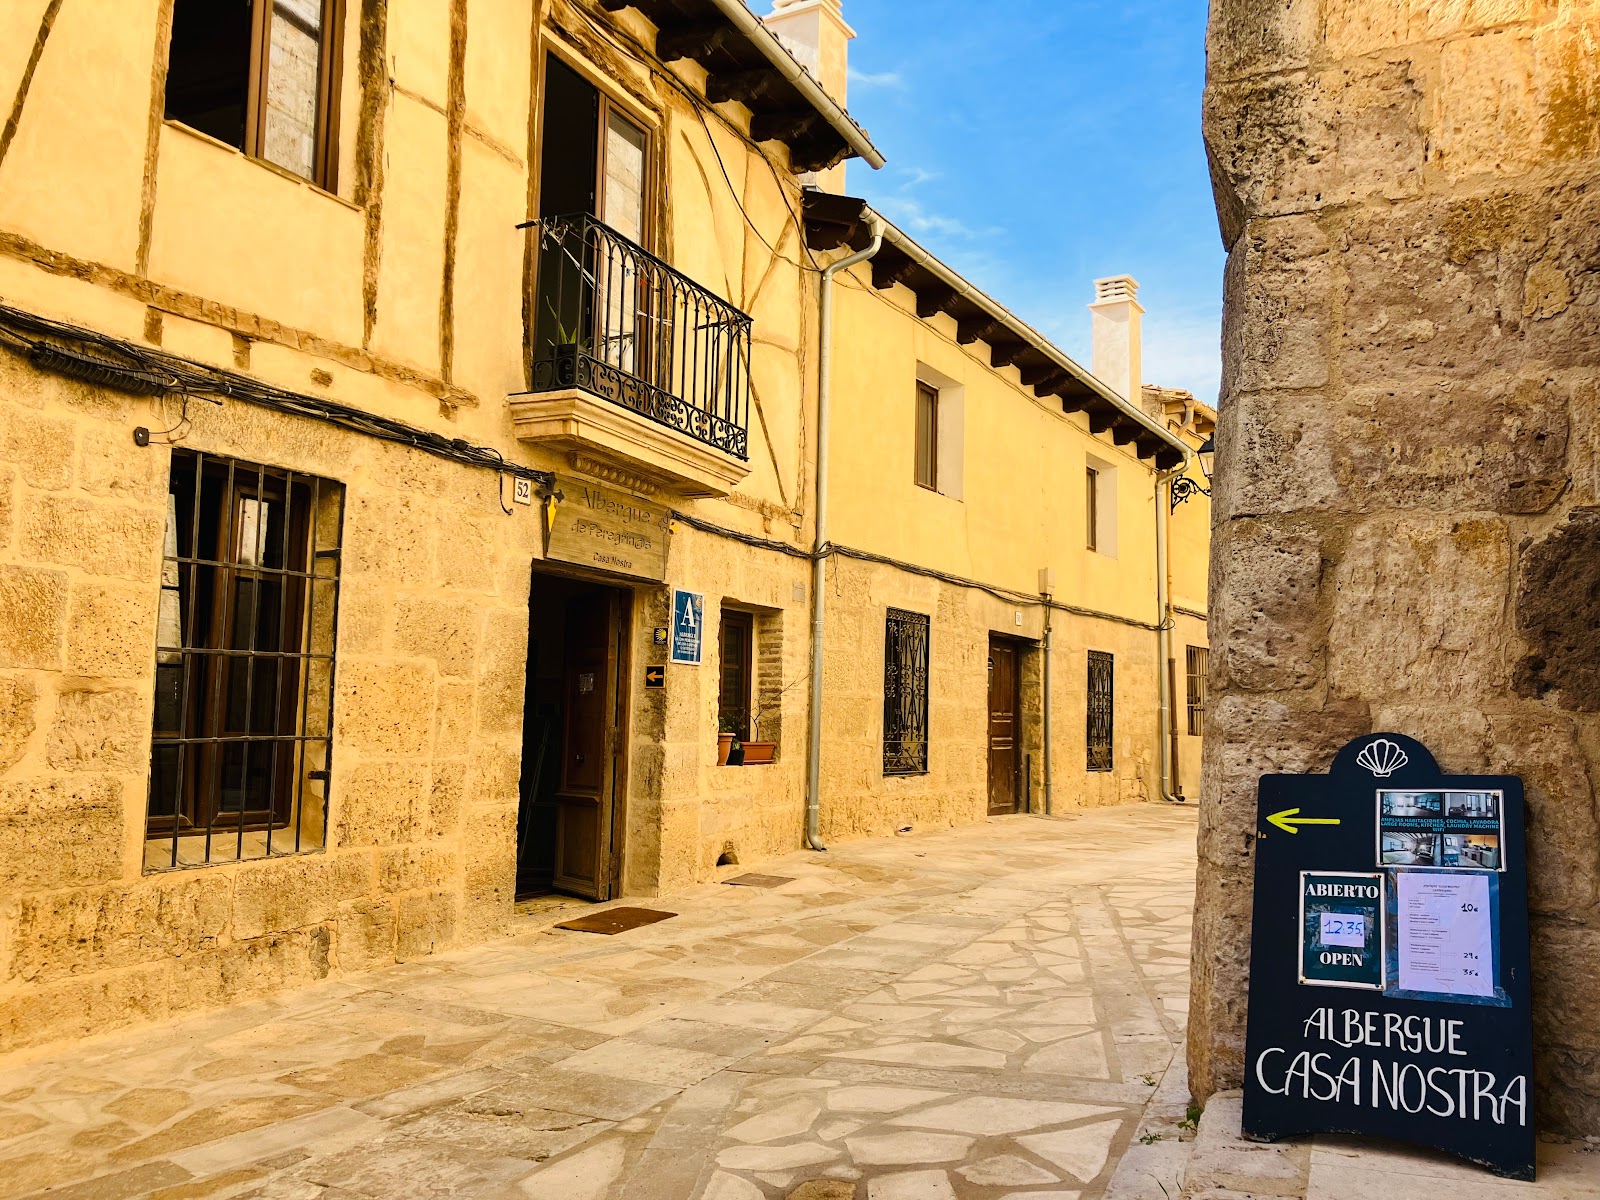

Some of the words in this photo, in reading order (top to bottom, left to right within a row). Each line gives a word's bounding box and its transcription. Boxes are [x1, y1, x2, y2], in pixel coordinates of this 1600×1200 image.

[517, 481, 529, 498] 52
[581, 487, 651, 523] Albergue
[571, 519, 586, 533] de
[593, 552, 610, 564] Casa
[611, 556, 632, 568] Nostra
[680, 596, 696, 627] A
[1305, 883, 1379, 899] ABIERTO
[1319, 952, 1364, 967] OPEN
[1303, 1007, 1467, 1055] ALBERGUE
[1256, 1047, 1360, 1105] CASA
[1372, 1058, 1526, 1126] NOSTRA
